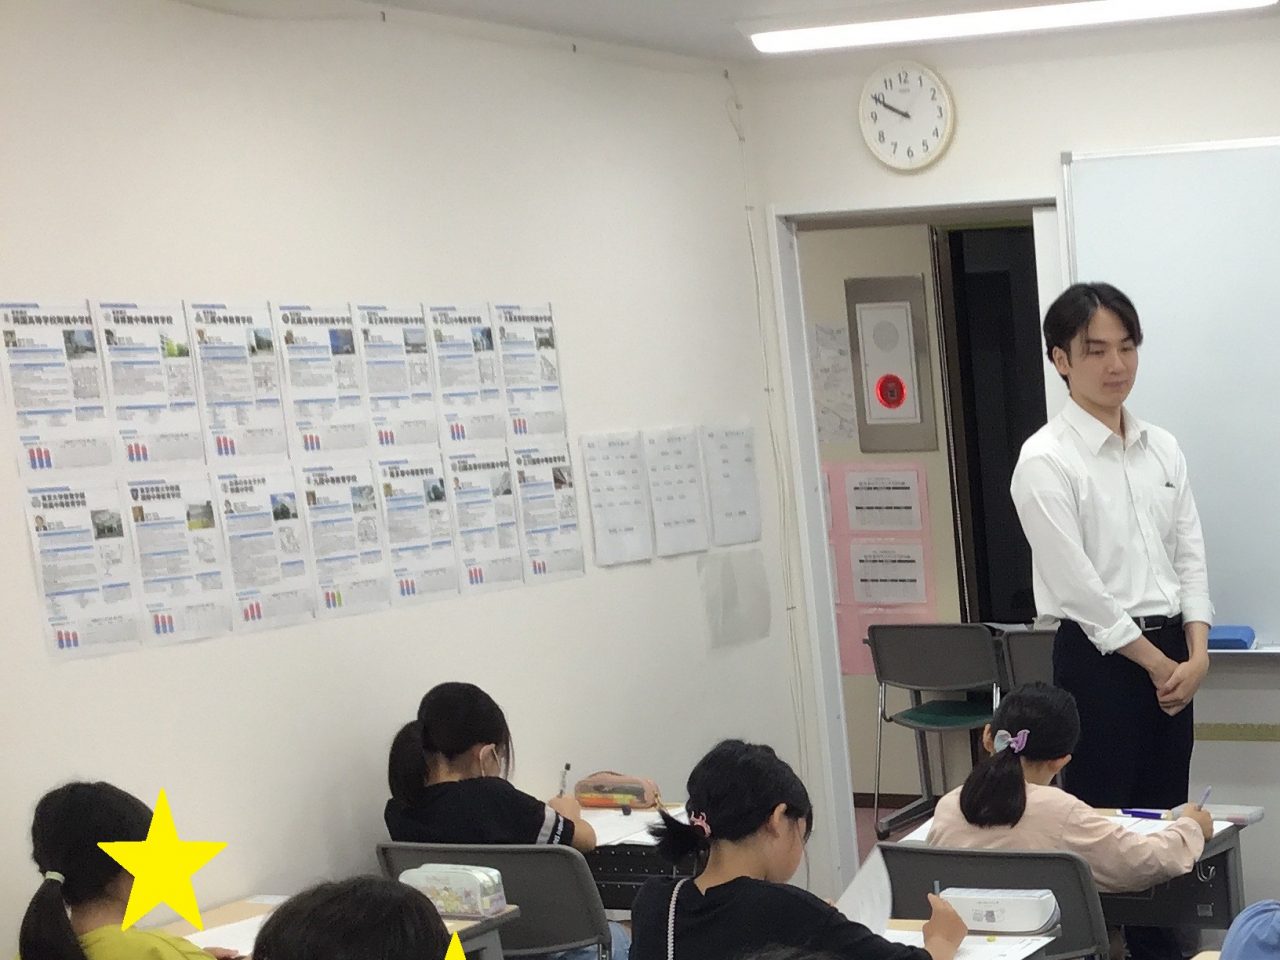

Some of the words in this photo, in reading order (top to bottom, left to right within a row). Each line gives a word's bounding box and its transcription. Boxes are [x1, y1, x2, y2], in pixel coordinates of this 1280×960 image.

[898, 71, 909, 84] 12
[919, 75, 923, 87] 1
[884, 78, 893, 90] 11
[871, 92, 885, 104] 10
[930, 88, 936, 101] 2
[871, 111, 877, 123] 9
[937, 106, 943, 118] 3
[878, 131, 885, 143] 8
[932, 127, 939, 138] 4
[891, 141, 898, 154] 7
[907, 146, 914, 158] 6
[922, 140, 929, 152] 5
